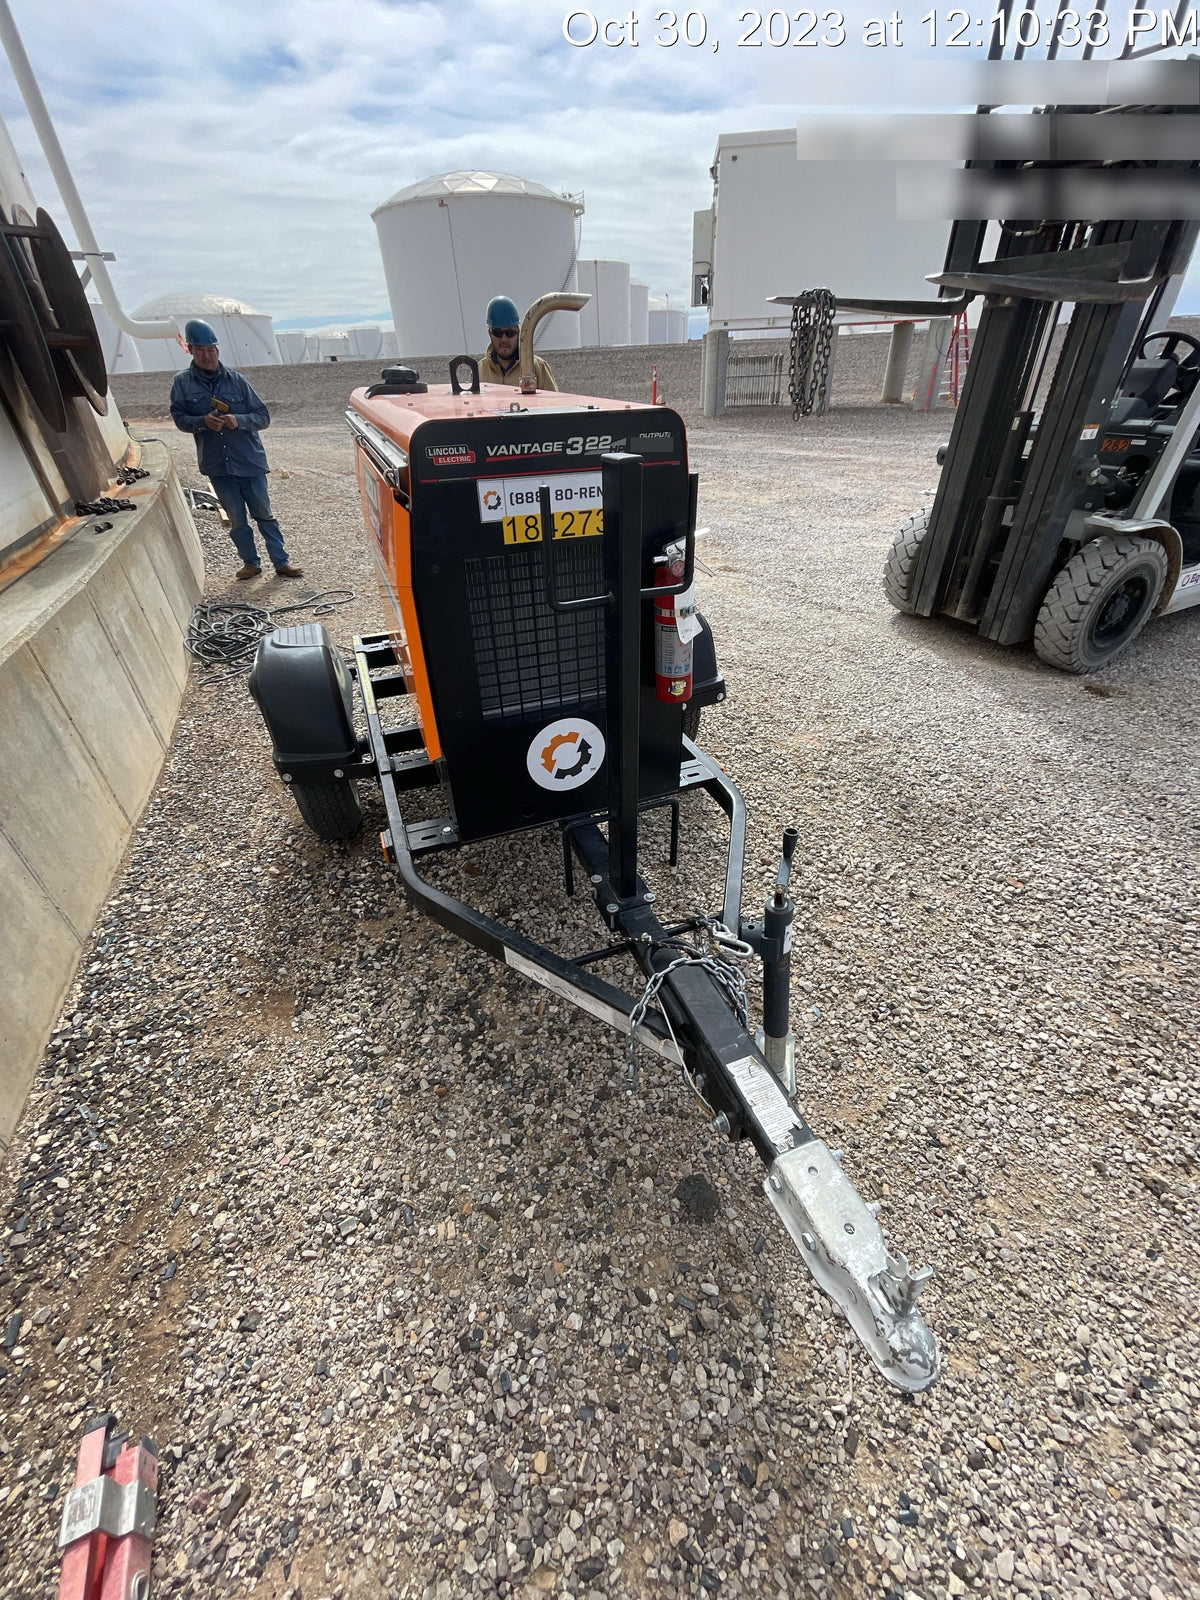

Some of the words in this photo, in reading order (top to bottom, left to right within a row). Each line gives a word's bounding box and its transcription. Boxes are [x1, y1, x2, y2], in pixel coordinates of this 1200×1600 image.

[427, 446, 467, 457] LINCOLN
[486, 441, 563, 457] VANTAGE
[566, 435, 612, 455] 322
[1103, 440, 1129, 453] 282
[438, 455, 472, 464] ELECTRIC
[509, 491, 542, 507] (888
